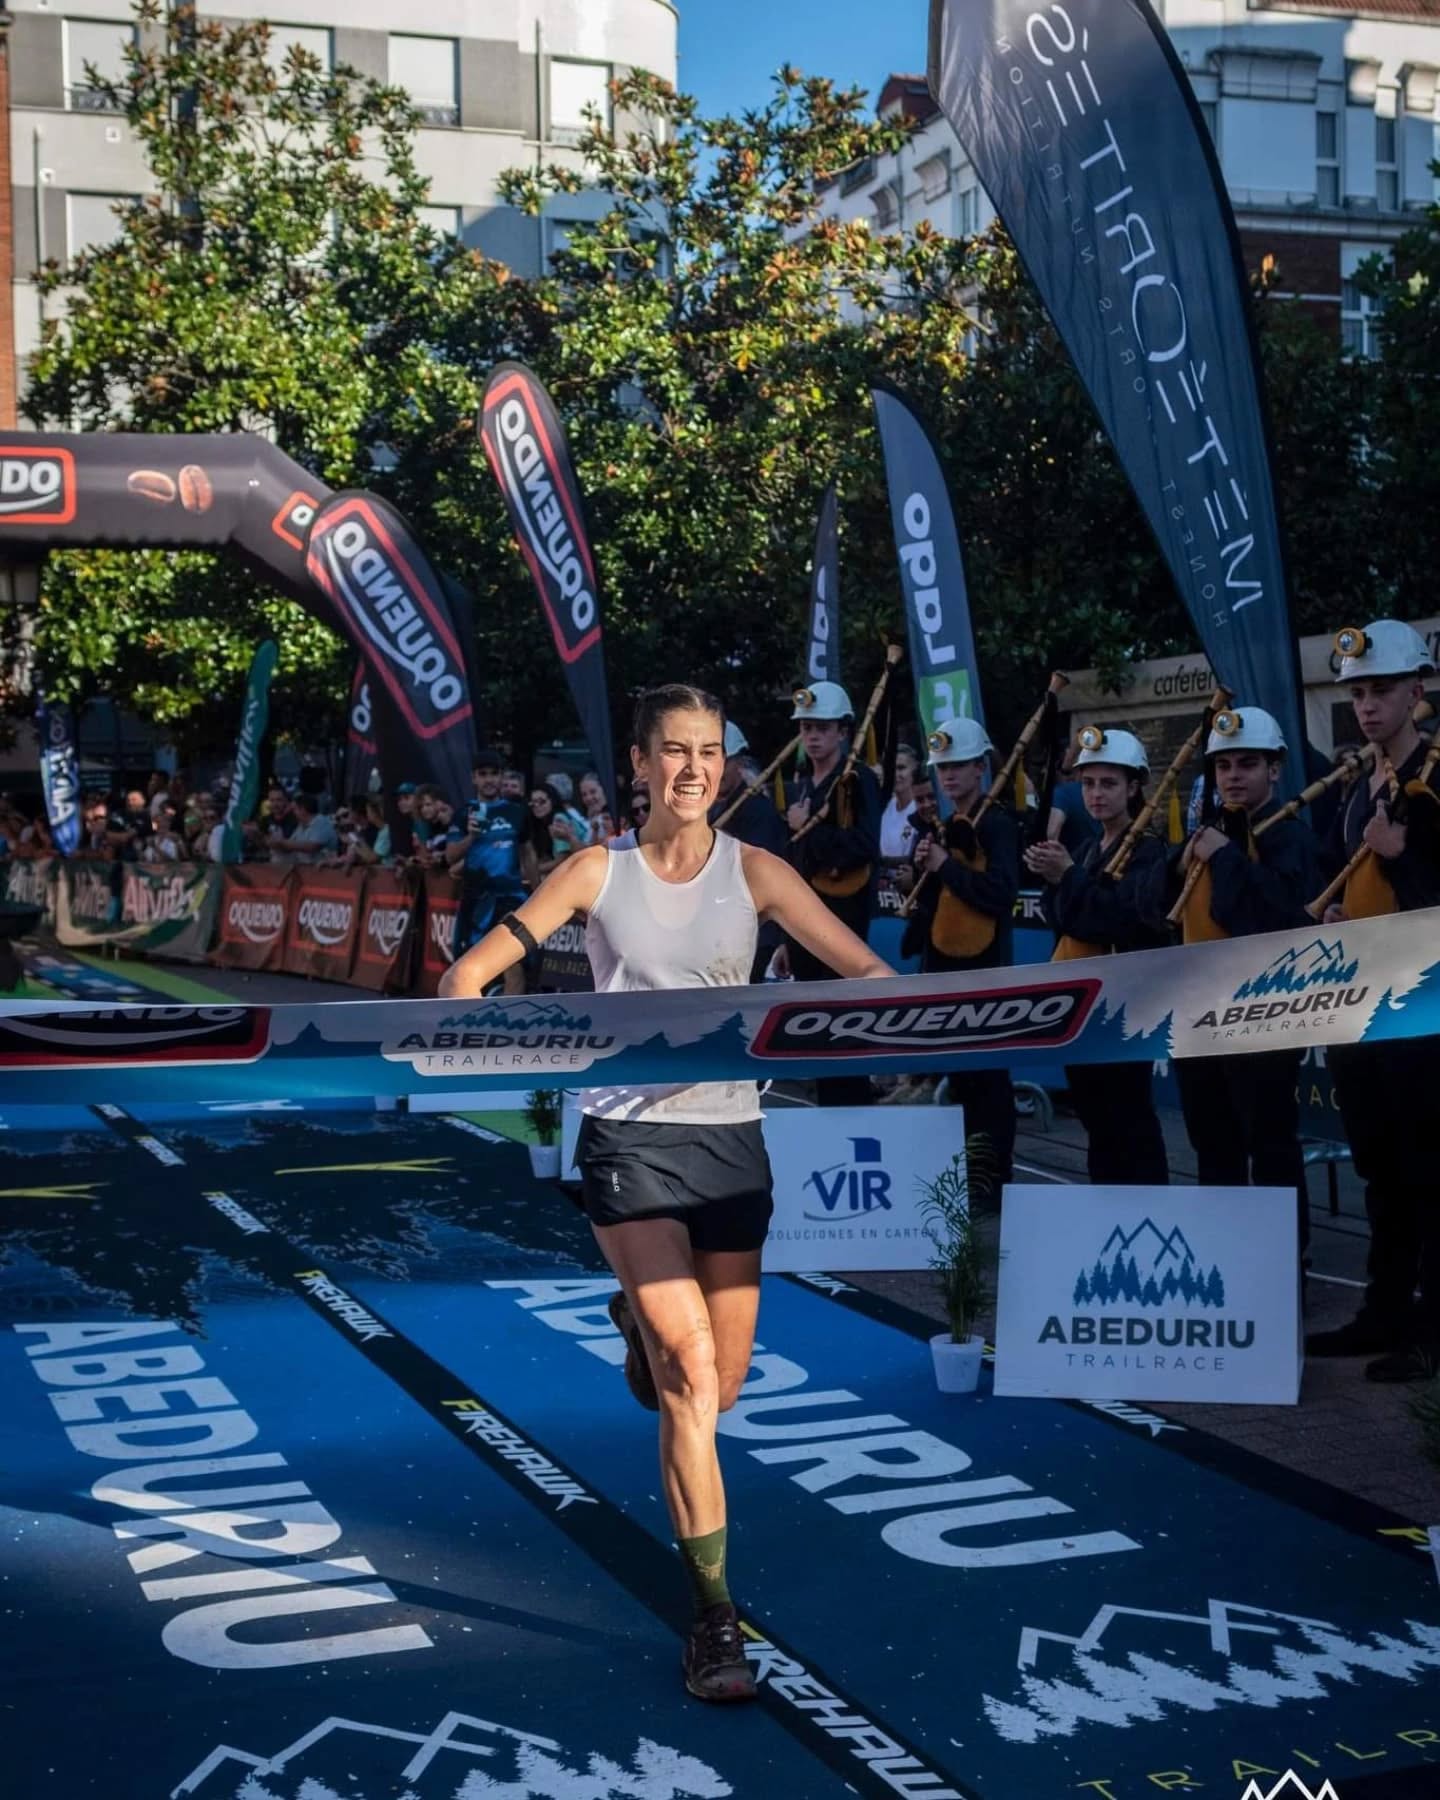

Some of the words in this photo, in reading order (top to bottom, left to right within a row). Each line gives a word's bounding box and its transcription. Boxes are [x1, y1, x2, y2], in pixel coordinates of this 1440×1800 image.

[1153, 663, 1215, 697] cafeter
[784, 995, 1076, 1045] OQUENDO
[1191, 985, 1370, 1029] ABEDURIU
[397, 1032, 616, 1050] ABEDURIU
[1211, 1014, 1338, 1040] TRAILRACE
[425, 1053, 581, 1067] TRAILRACE
[811, 1170, 892, 1211] VIR
[861, 1228, 878, 1239] EN
[293, 1269, 396, 1342] FIREHAWK
[1037, 1315, 1256, 1349] ABEDURIU
[1065, 1353, 1225, 1371] TRAILRACE
[440, 1399, 600, 1512] FIREHAWK
[14, 1321, 435, 1670] ABEDURIU
[738, 1620, 968, 1800] IREHAW
